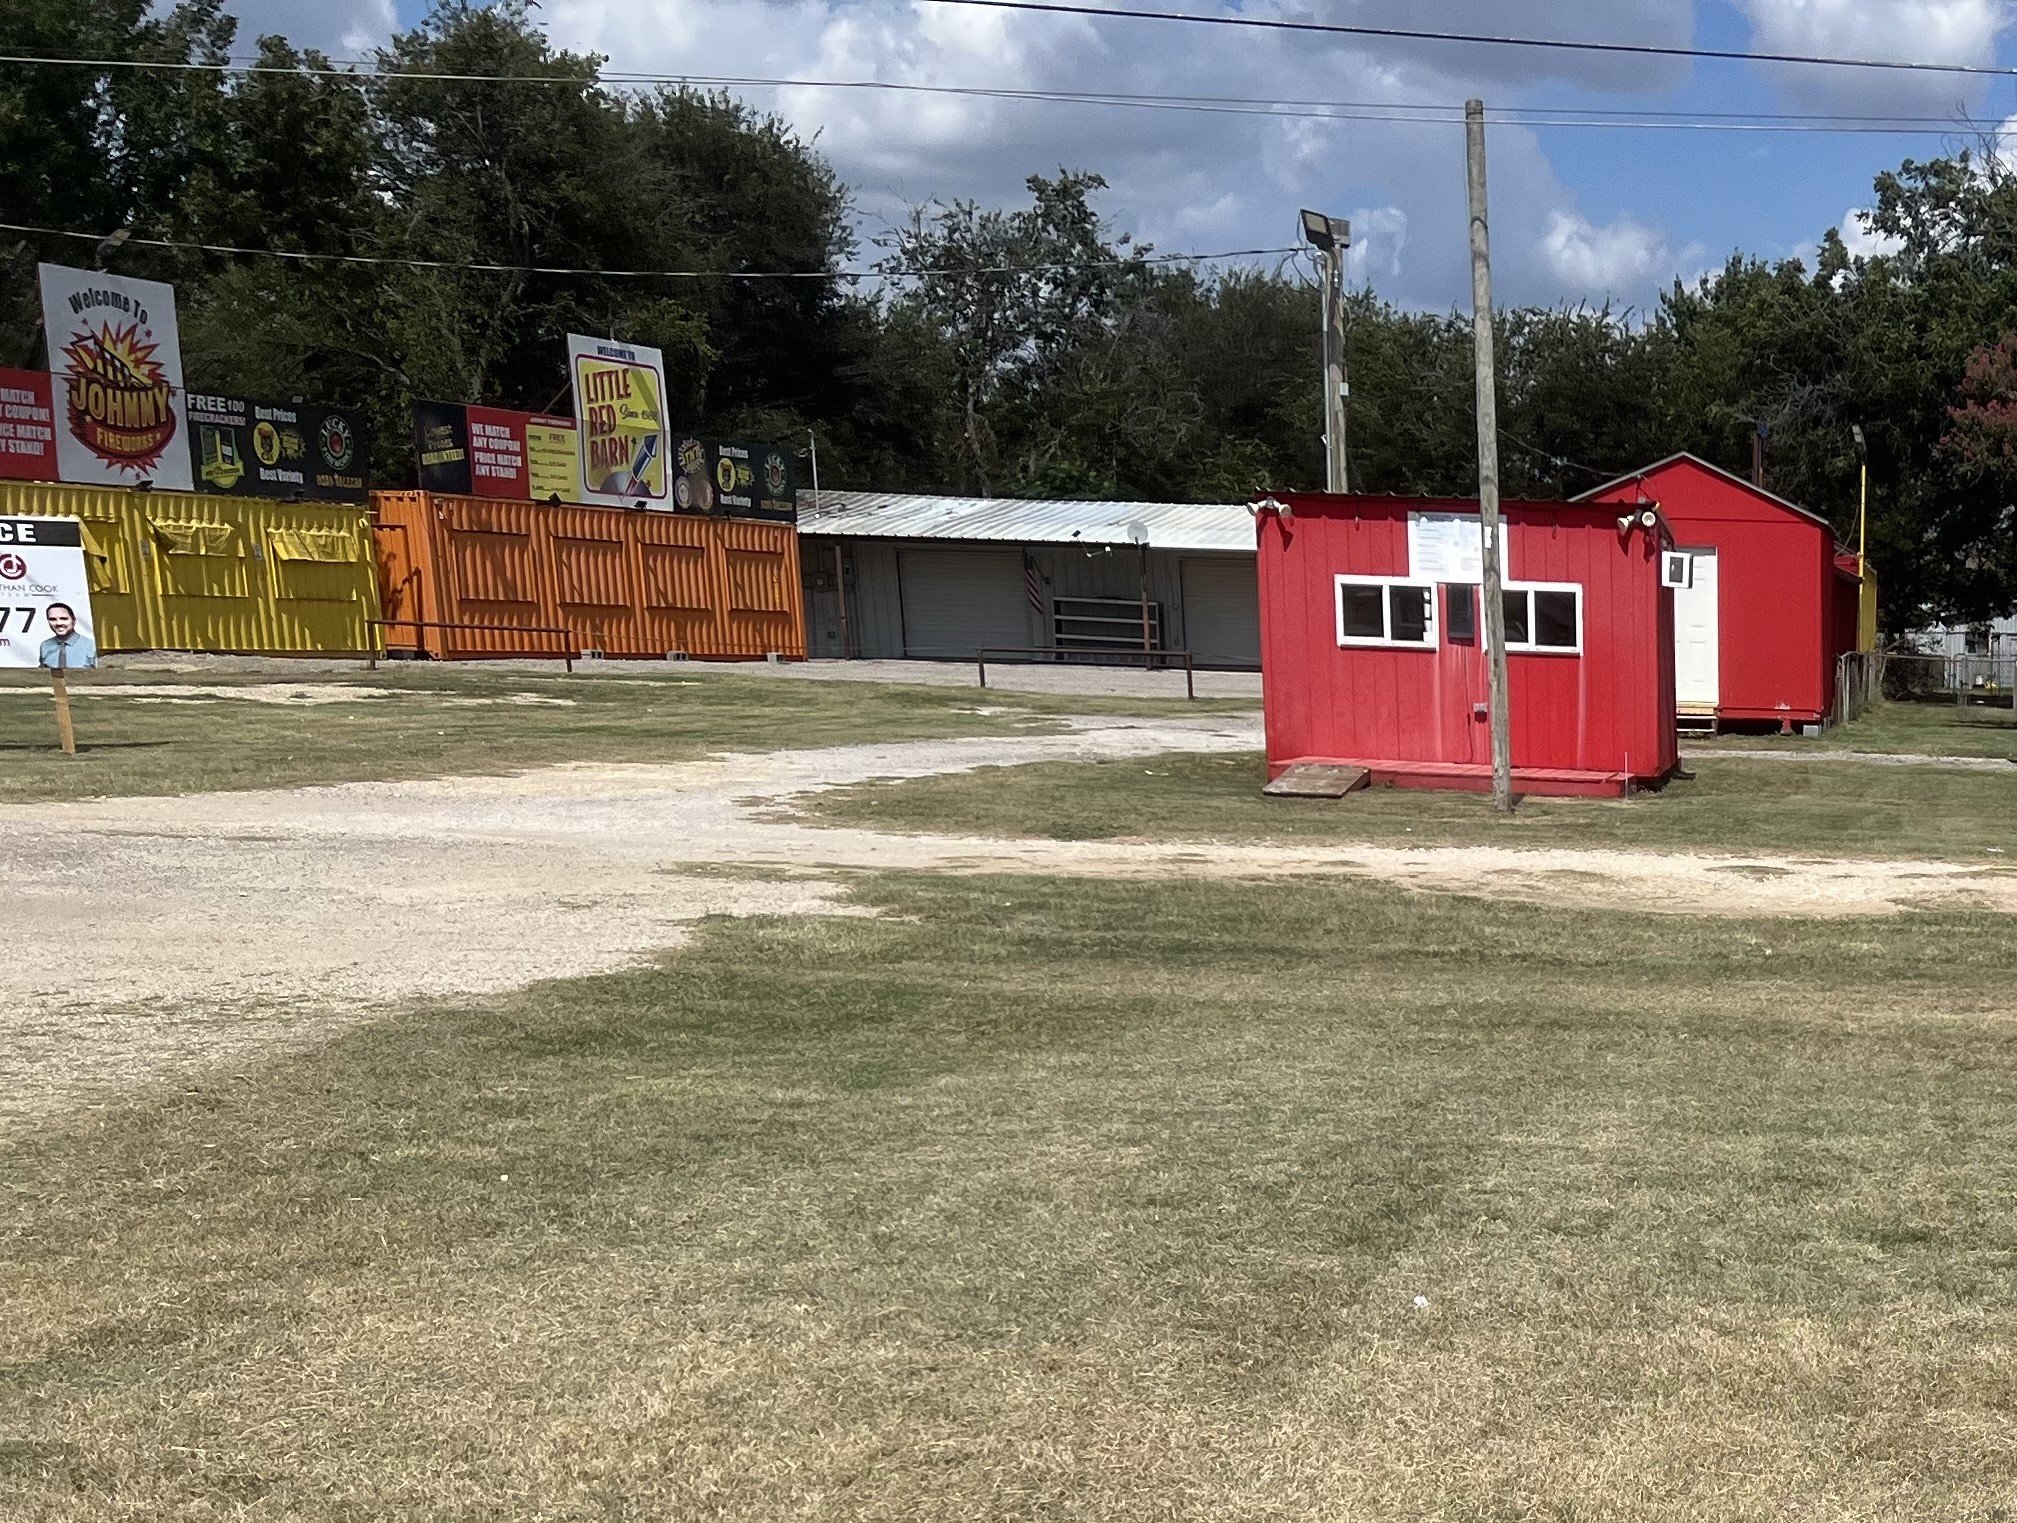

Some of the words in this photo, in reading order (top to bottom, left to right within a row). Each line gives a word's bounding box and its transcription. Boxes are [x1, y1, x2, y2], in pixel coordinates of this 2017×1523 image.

[69, 288, 131, 315] Welcome
[596, 345, 626, 360] WELCOME
[585, 367, 632, 405] LITTLE
[71, 377, 170, 429] JOHNNY
[187, 393, 227, 412] FREE
[228, 400, 245, 413] 100
[321, 417, 351, 438] LUCKY
[471, 422, 485, 436] WE
[588, 404, 617, 437] RED
[16, 424, 51, 440] MATCH
[96, 427, 155, 453] FIREWORKS
[589, 435, 630, 472] BARN
[0, 522, 37, 543] CE
[29, 584, 60, 593] COOK
